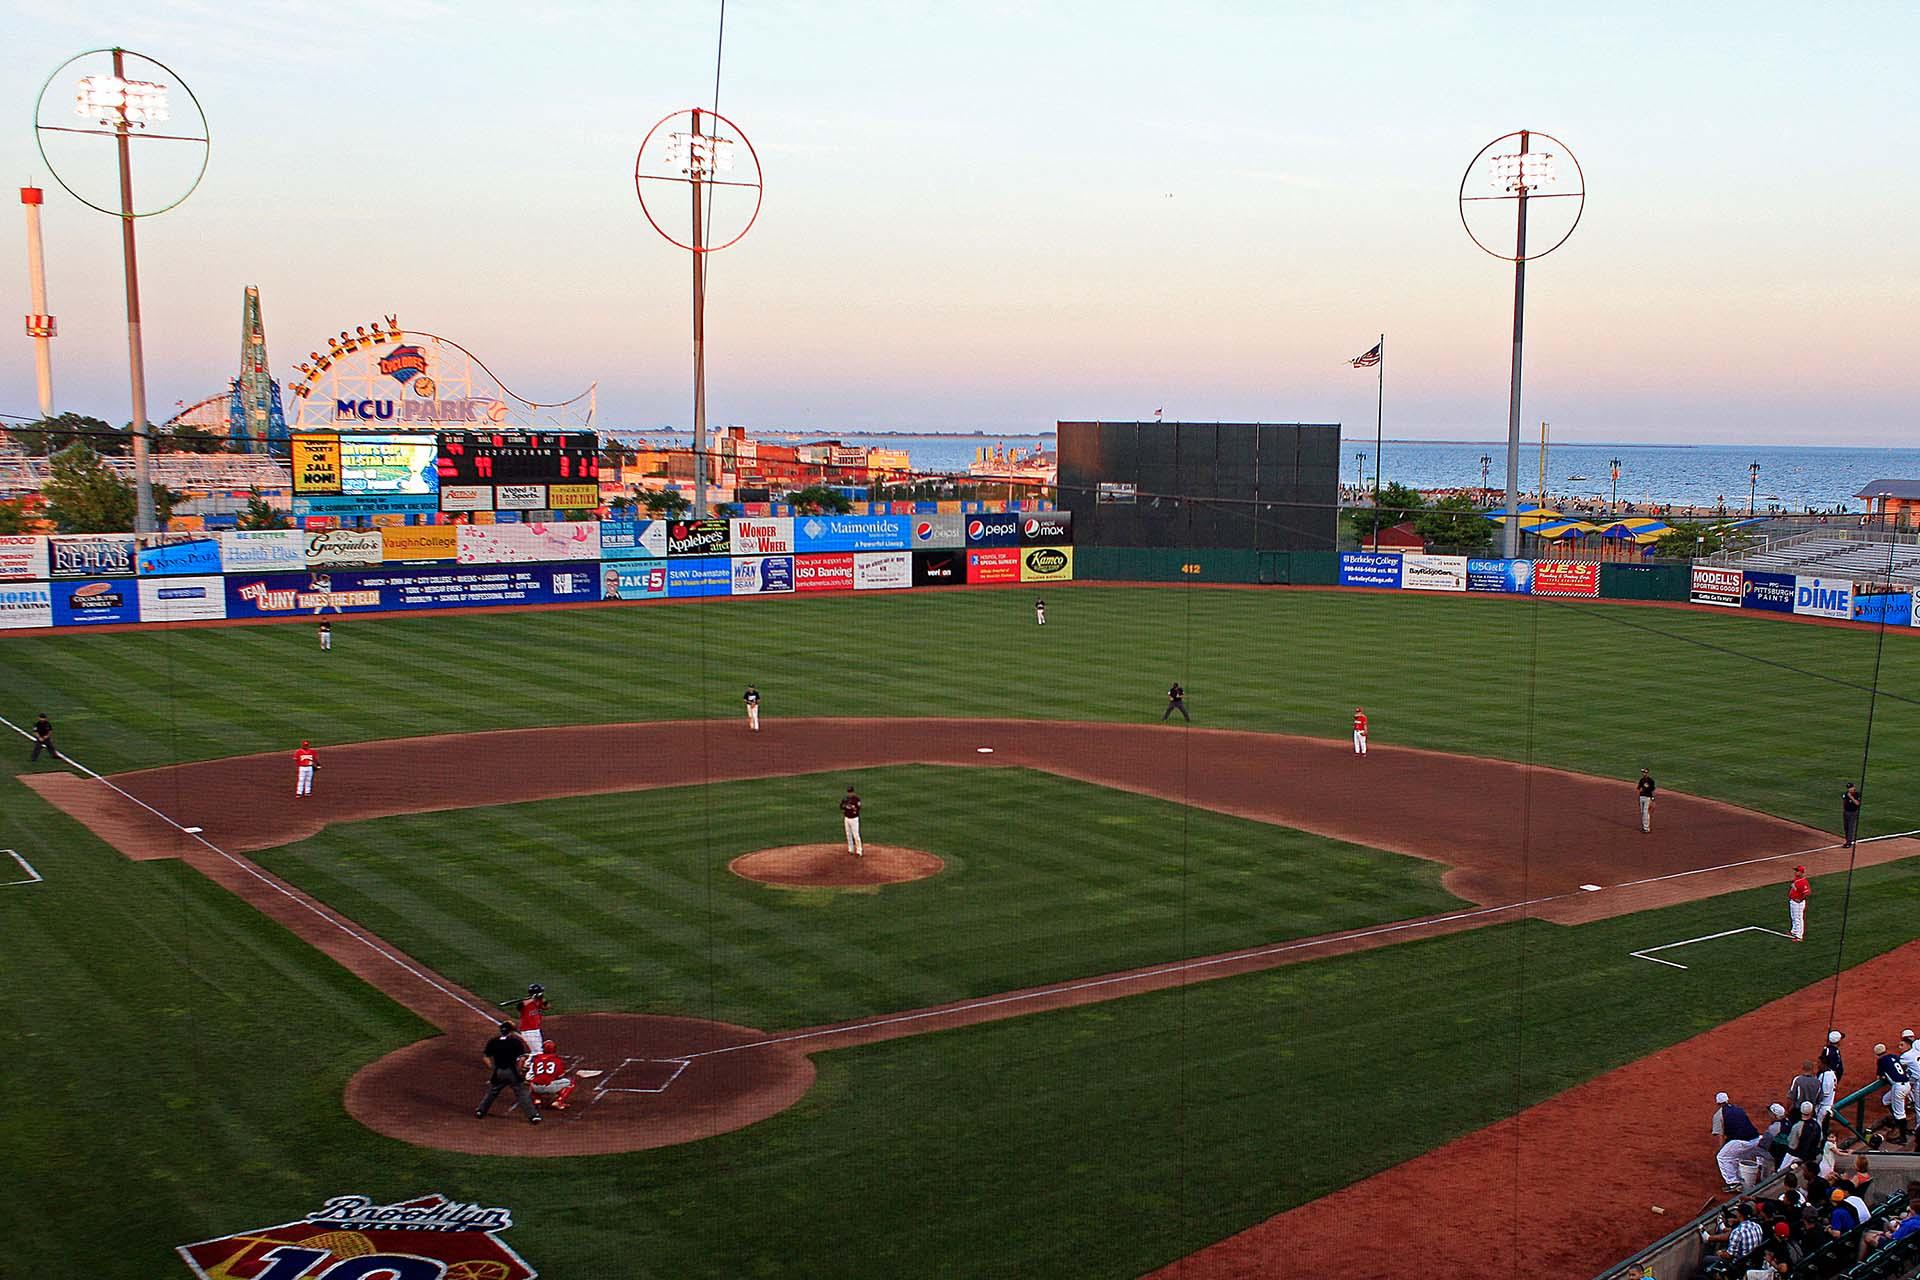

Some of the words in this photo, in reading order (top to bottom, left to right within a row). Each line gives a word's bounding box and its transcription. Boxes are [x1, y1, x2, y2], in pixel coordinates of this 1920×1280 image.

[381, 356, 426, 374] CYCLONES
[336, 400, 394, 420] MCU
[404, 400, 478, 421] PARK
[306, 463, 335, 471] SALE
[304, 473, 336, 483] NOW!
[739, 522, 776, 538] WONDER
[831, 520, 899, 533] Maimonides
[985, 522, 1016, 536] pepsi
[1041, 525, 1064, 535] max
[383, 537, 456, 549] VaughnCollege
[668, 531, 723, 552] Applebee's
[757, 538, 787, 552] WHEEL
[56, 552, 130, 568] REHAB
[189, 552, 218, 563] PLAZA
[229, 547, 267, 560] Health
[1031, 551, 1064, 566] Kamco
[822, 558, 840, 566] support
[1350, 555, 1375, 565] Berkeley
[1375, 556, 1399, 566] College
[670, 570, 690, 578] SUNY
[735, 566, 757, 578] WFAN
[796, 568, 815, 578] USO
[818, 567, 853, 577] Banking
[1181, 564, 1201, 574] 412
[1539, 563, 1592, 575] J.E.S.
[618, 575, 650, 587] TAKE
[650, 573, 662, 588] 5
[1693, 572, 1740, 586] MODELL'S
[240, 583, 268, 600] TEAM
[1754, 586, 1795, 597] PITTSBURGH
[1758, 593, 1789, 603] PAINTS
[258, 592, 297, 608] CUNY
[298, 593, 328, 607] TAKES
[328, 592, 349, 606] THE
[350, 591, 380, 605] FIELD!
[1893, 1062, 1904, 1075] 8
[307, 1195, 514, 1229] Brooklyn
